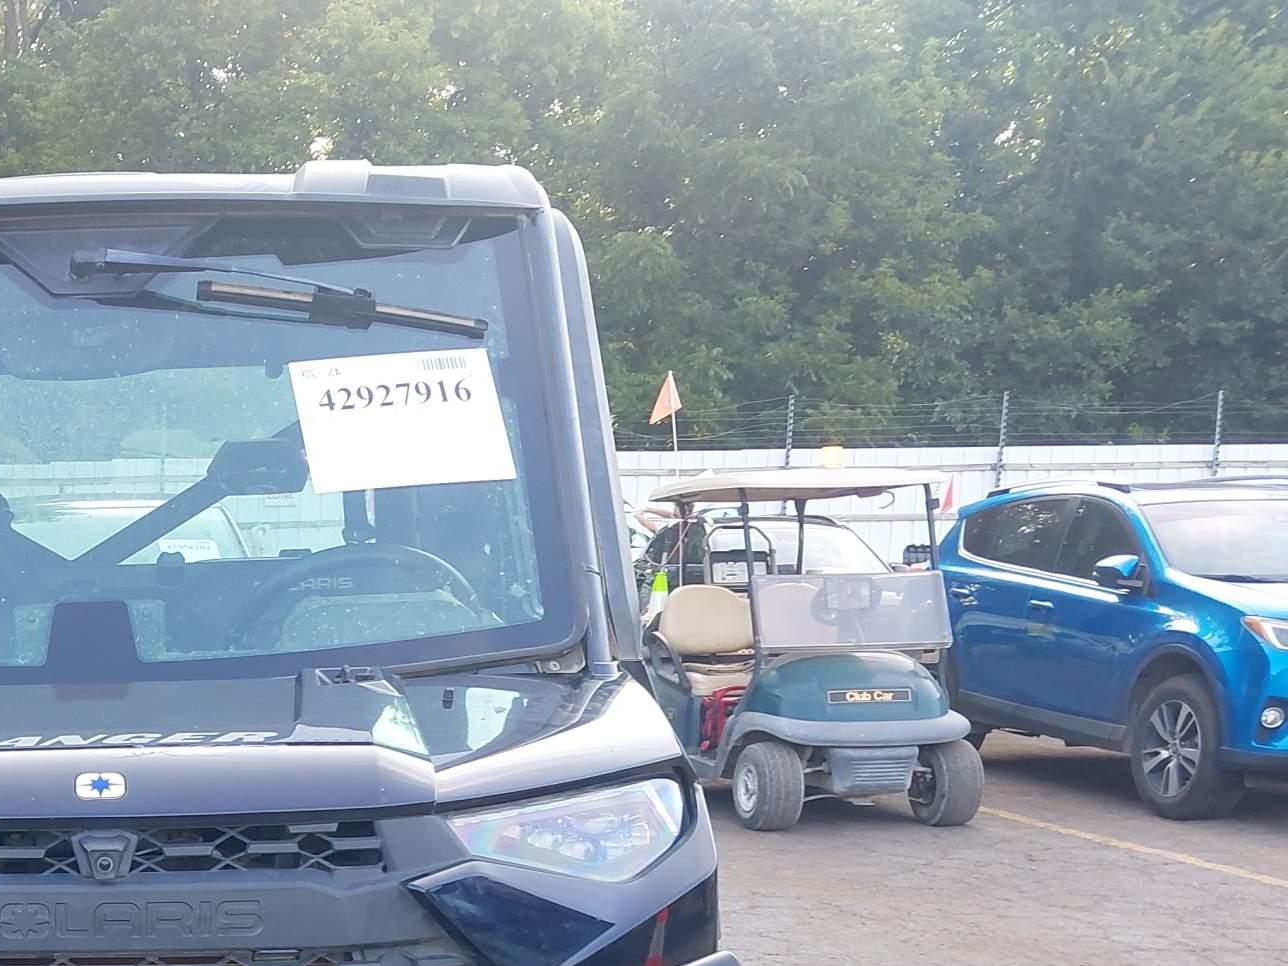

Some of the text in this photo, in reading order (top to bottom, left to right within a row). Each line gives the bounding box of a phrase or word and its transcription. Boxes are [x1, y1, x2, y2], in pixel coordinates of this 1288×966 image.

[318, 378, 472, 411] 42927916
[288, 577, 353, 591] ARIS
[845, 691, 895, 701] Club Car
